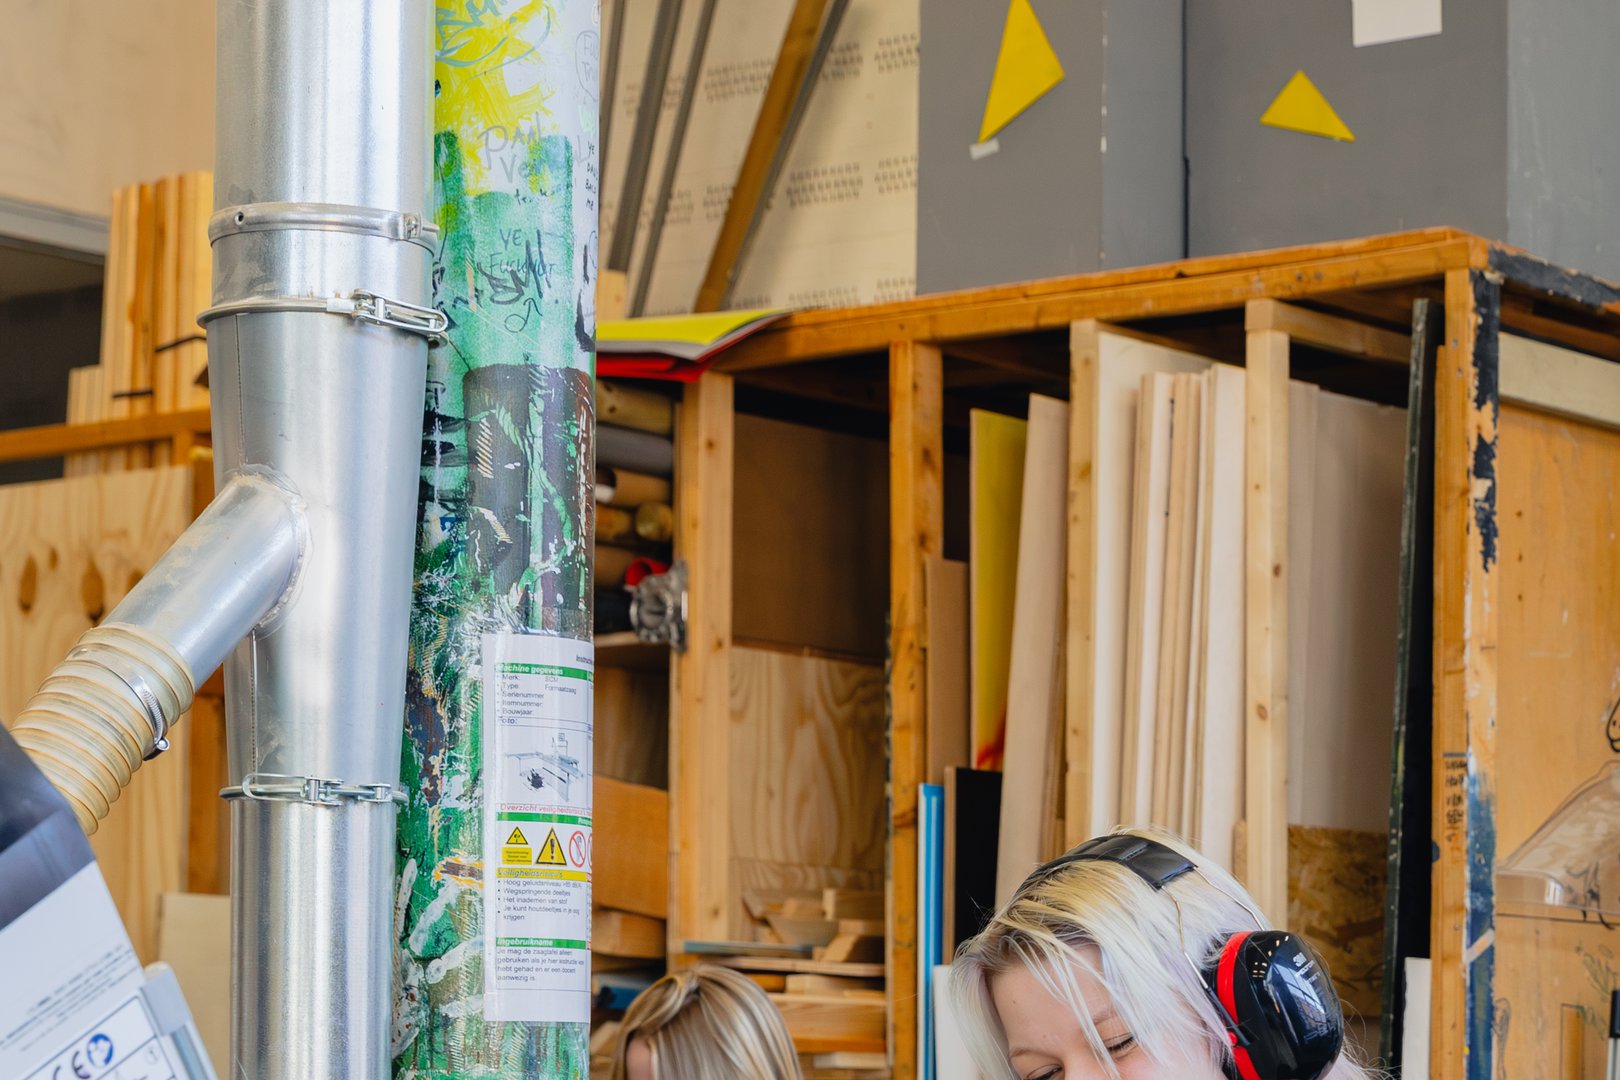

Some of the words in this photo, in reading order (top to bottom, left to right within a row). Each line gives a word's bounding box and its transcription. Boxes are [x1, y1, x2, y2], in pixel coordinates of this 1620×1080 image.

[500, 804, 537, 812] Overzicht
[503, 888, 552, 896] Wegspringende
[1293, 952, 1307, 968] 3M
